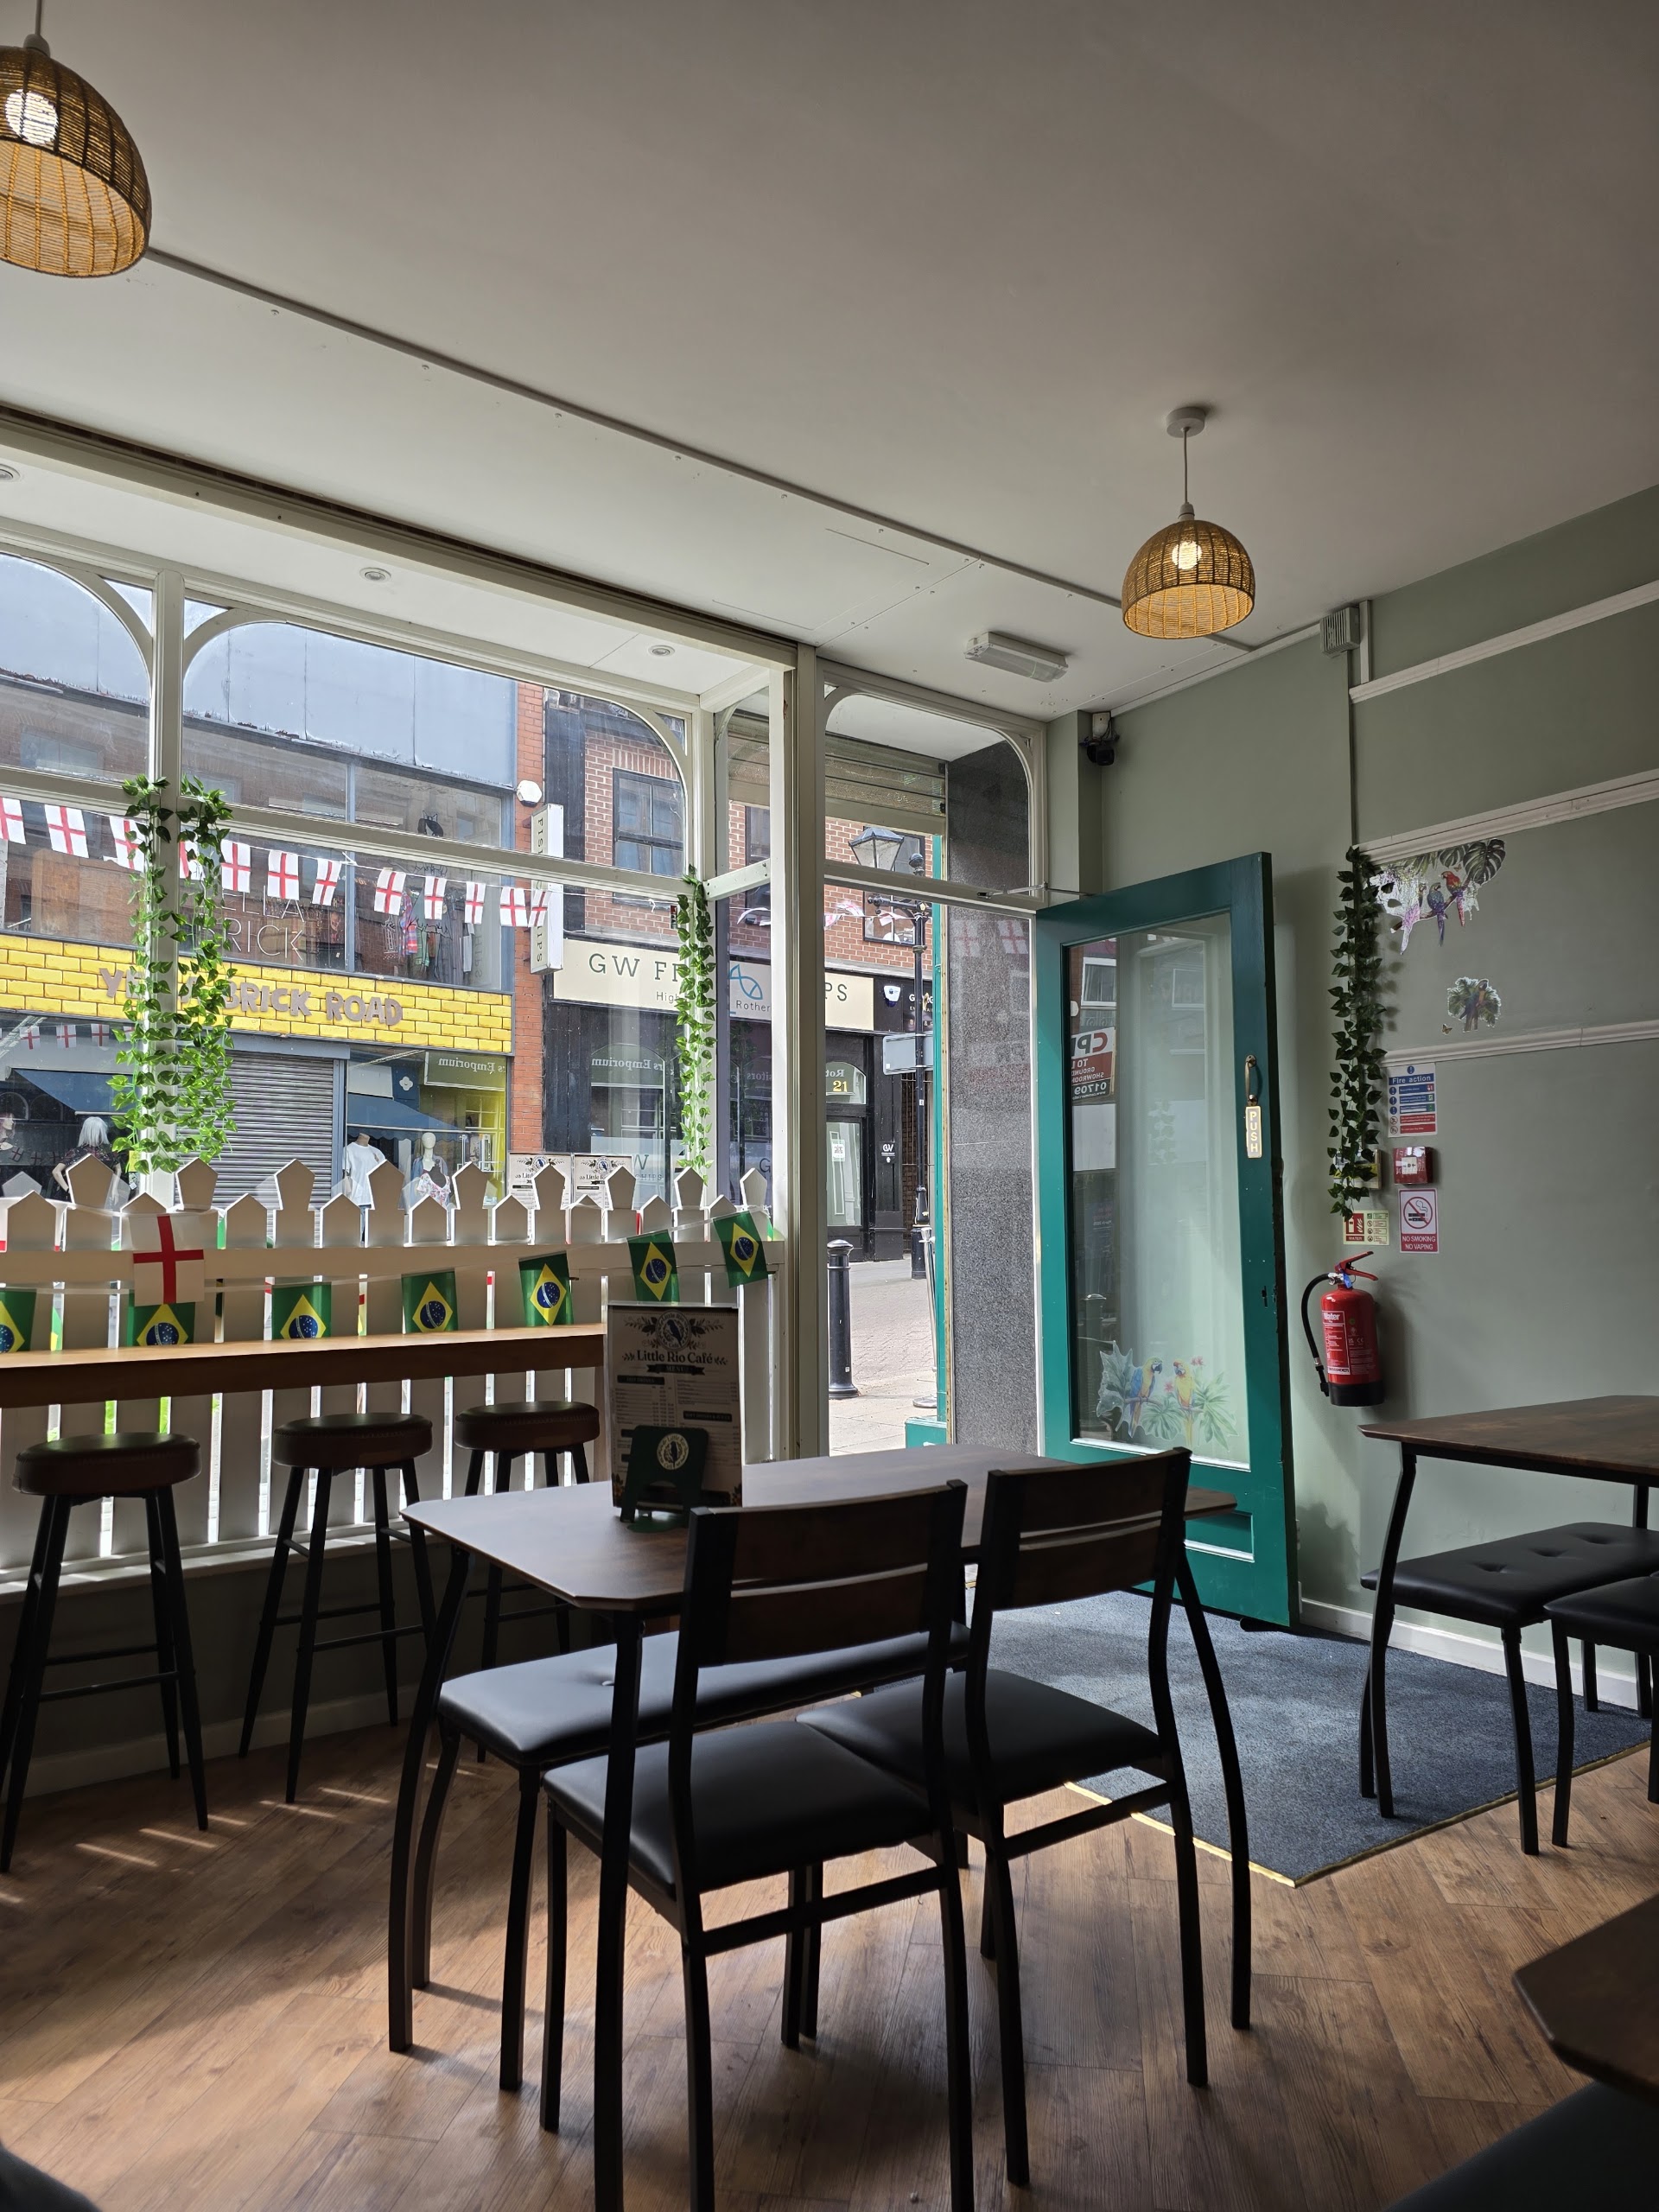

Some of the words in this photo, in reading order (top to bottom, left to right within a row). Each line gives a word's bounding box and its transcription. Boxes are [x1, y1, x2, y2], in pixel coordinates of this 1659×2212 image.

[588, 953, 640, 977] GW
[221, 979, 312, 1017] BRICK
[325, 991, 403, 1026] ROAD
[735, 1000, 771, 1012] Rother
[832, 1080, 848, 1092] 21
[1249, 1111, 1258, 1153] PUSH
[637, 1350, 665, 1363] Little
[667, 1351, 686, 1363] Rio
[687, 1352, 713, 1364] Café
